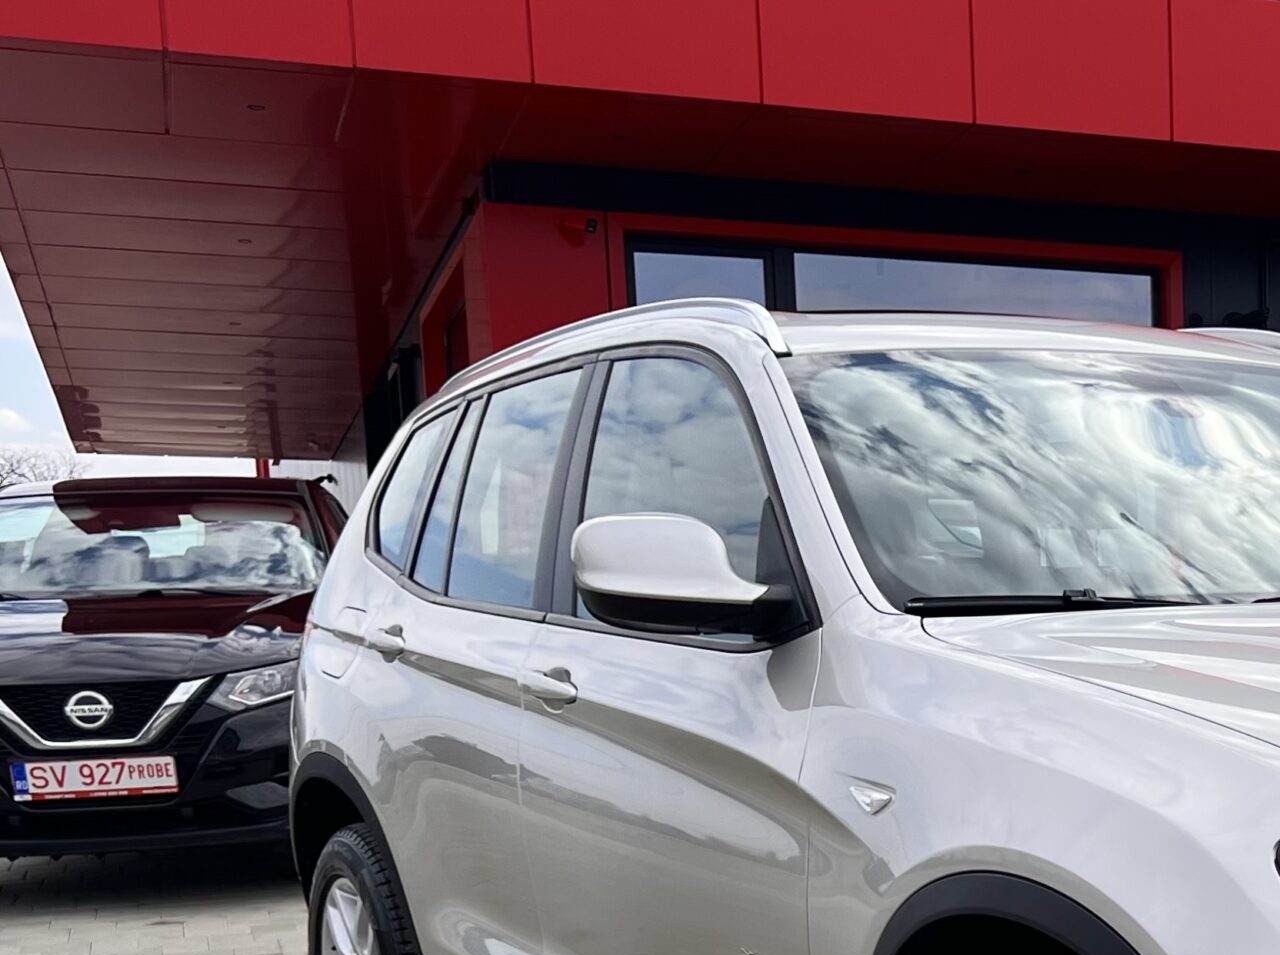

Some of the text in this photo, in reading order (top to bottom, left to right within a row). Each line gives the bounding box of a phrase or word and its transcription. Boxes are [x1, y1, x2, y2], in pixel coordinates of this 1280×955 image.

[30, 761, 173, 789] SV 927 PROBE
[16, 780, 28, 790] RO
